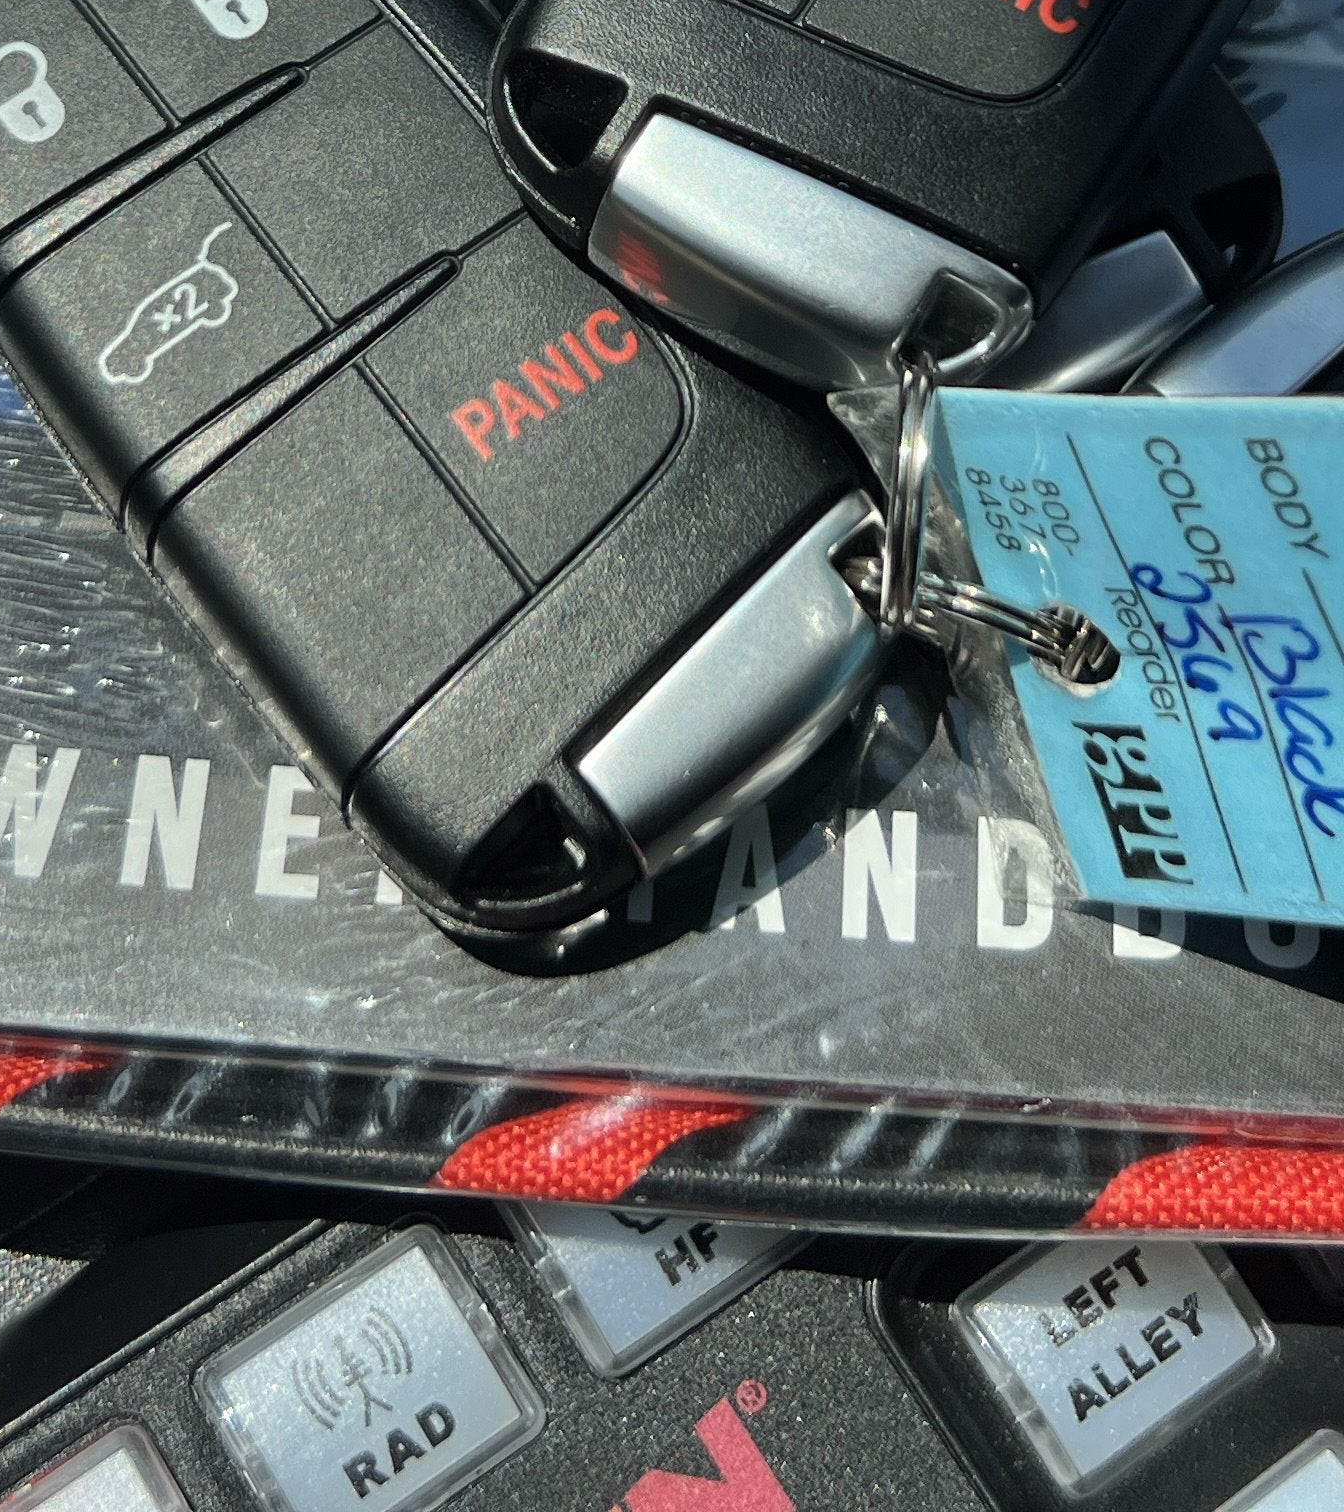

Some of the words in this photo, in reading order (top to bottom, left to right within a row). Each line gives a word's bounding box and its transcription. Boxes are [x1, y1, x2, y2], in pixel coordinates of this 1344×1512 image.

[450, 307, 639, 463] PANIC
[964, 466, 1023, 553] 8458
[1145, 436, 1236, 588] COLOR
[1244, 437, 1330, 562] BODY
[1105, 586, 1184, 724] Reorder
[1130, 562, 1265, 744] 2569
[655, 1219, 721, 1288] HF
[1037, 1245, 1151, 1347] LEFT
[1066, 1291, 1204, 1423] ALLEY
[340, 1400, 457, 1499] RAD
